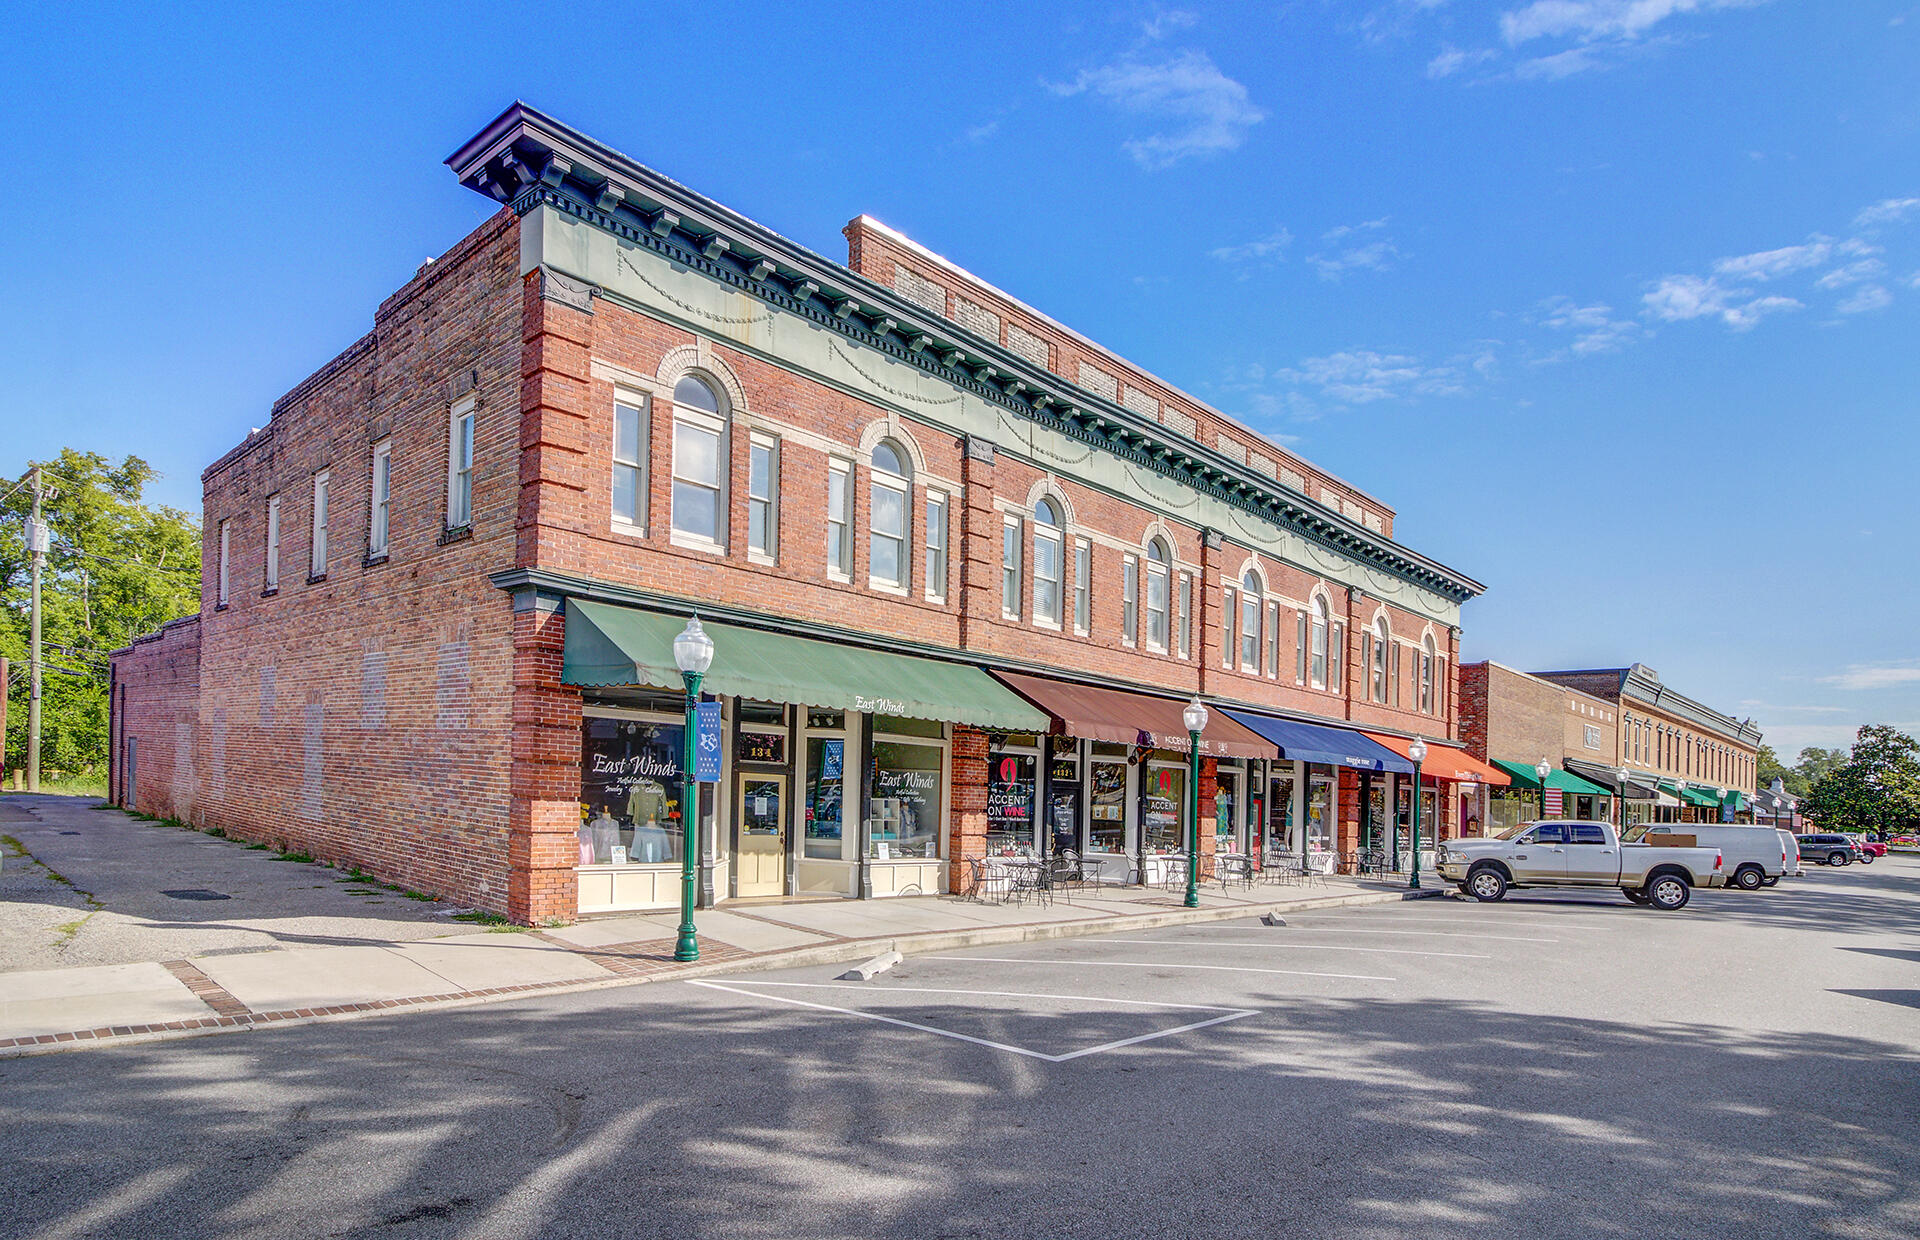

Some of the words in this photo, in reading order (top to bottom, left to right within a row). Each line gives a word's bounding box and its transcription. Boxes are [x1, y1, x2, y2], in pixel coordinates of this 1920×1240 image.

[855, 695, 875, 710] East
[877, 698, 905, 714] Winds
[592, 752, 627, 774] East
[629, 754, 677, 777] Winds
[879, 770, 901, 787] East
[903, 771, 935, 789] Winds
[988, 795, 1027, 806] ACCENT
[1150, 801, 1179, 811] ACCENT
[987, 806, 1002, 817] ON
[1003, 806, 1026, 817] WINE
